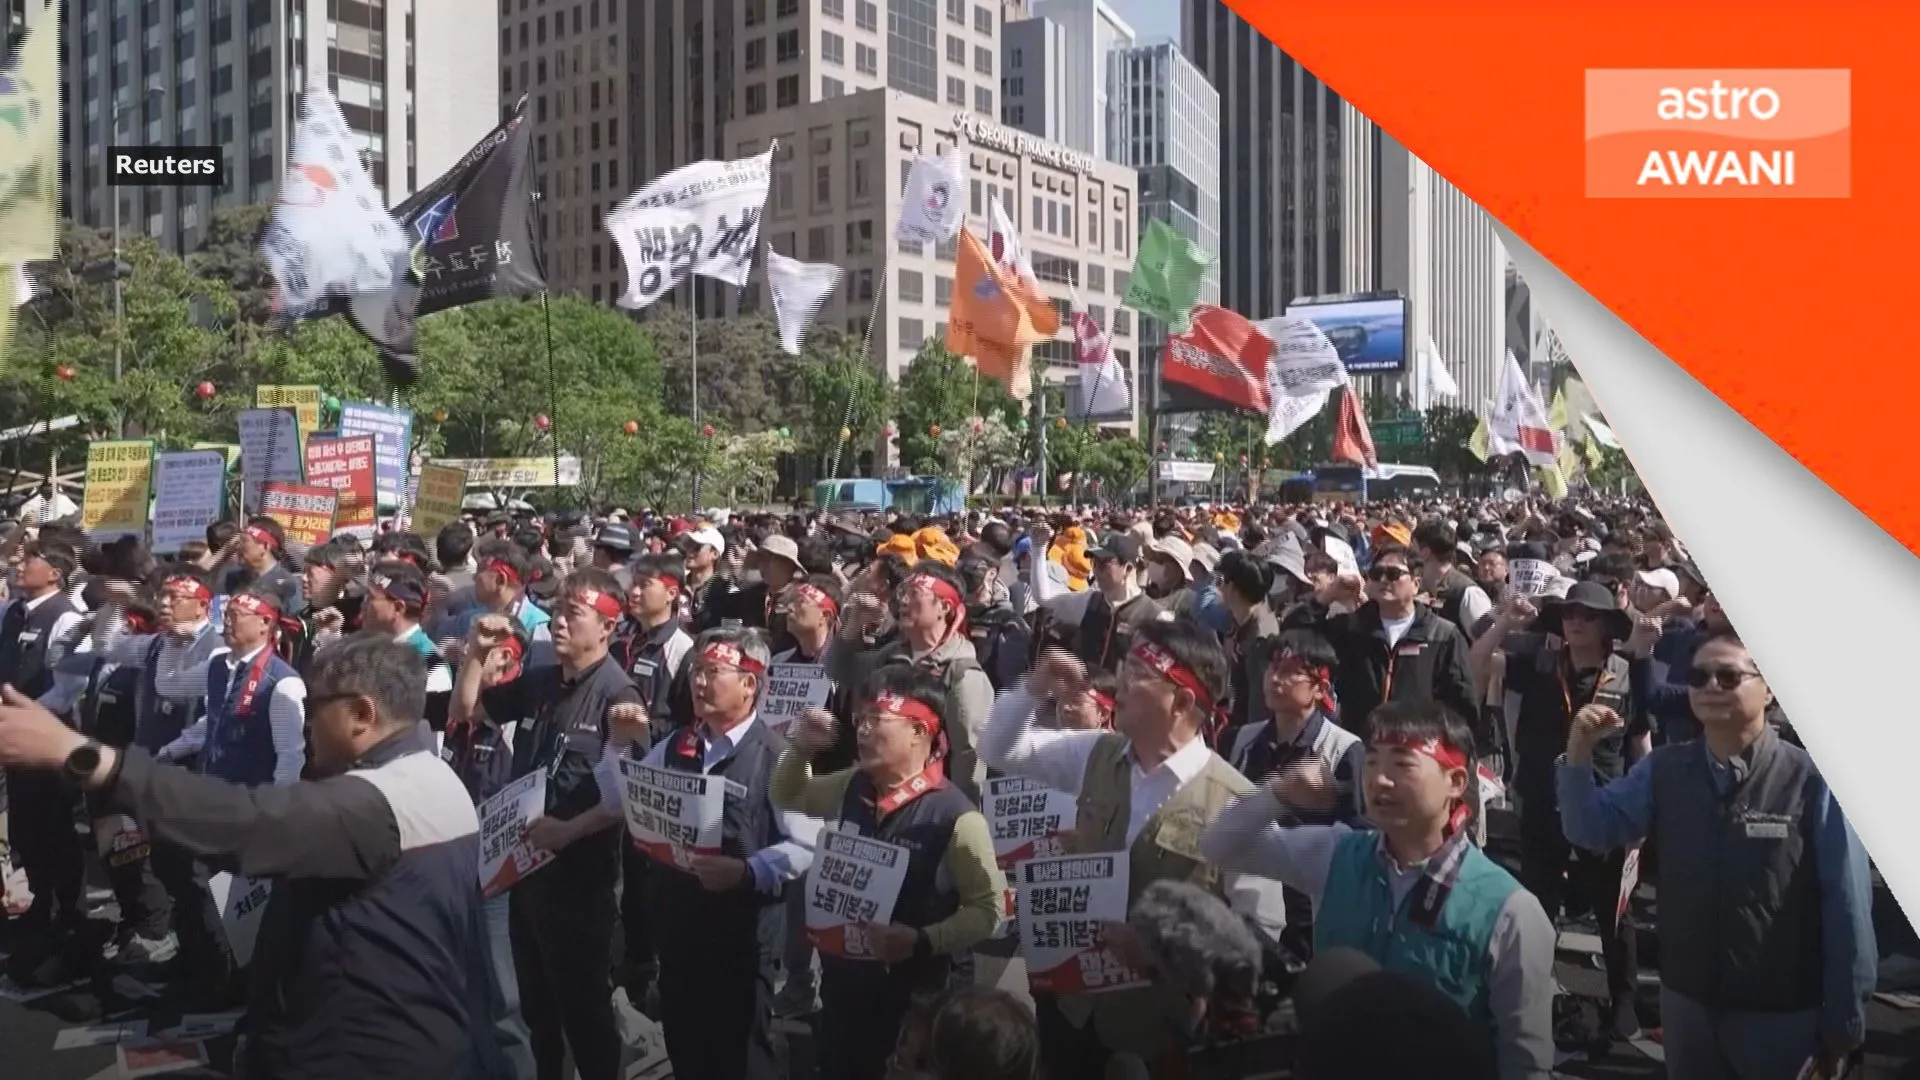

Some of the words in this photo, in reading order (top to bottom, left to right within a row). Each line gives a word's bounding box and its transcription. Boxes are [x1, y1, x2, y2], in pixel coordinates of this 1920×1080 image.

[978, 120, 1016, 151] SEOUL
[1018, 136, 1061, 165] FINANCE
[768, 680, 810, 697] 원청교섭
[764, 700, 817, 716] 노동기본
[627, 781, 682, 818] 원청교섭
[995, 793, 1048, 817] 원청교섭
[483, 798, 520, 840] 원청교섭
[631, 805, 699, 844] 노동기본권
[994, 814, 1061, 839] 노동기본권
[820, 855, 873, 892] 원청교섭
[812, 885, 880, 921] 노동기본권
[1031, 885, 1090, 915] 원청교섭
